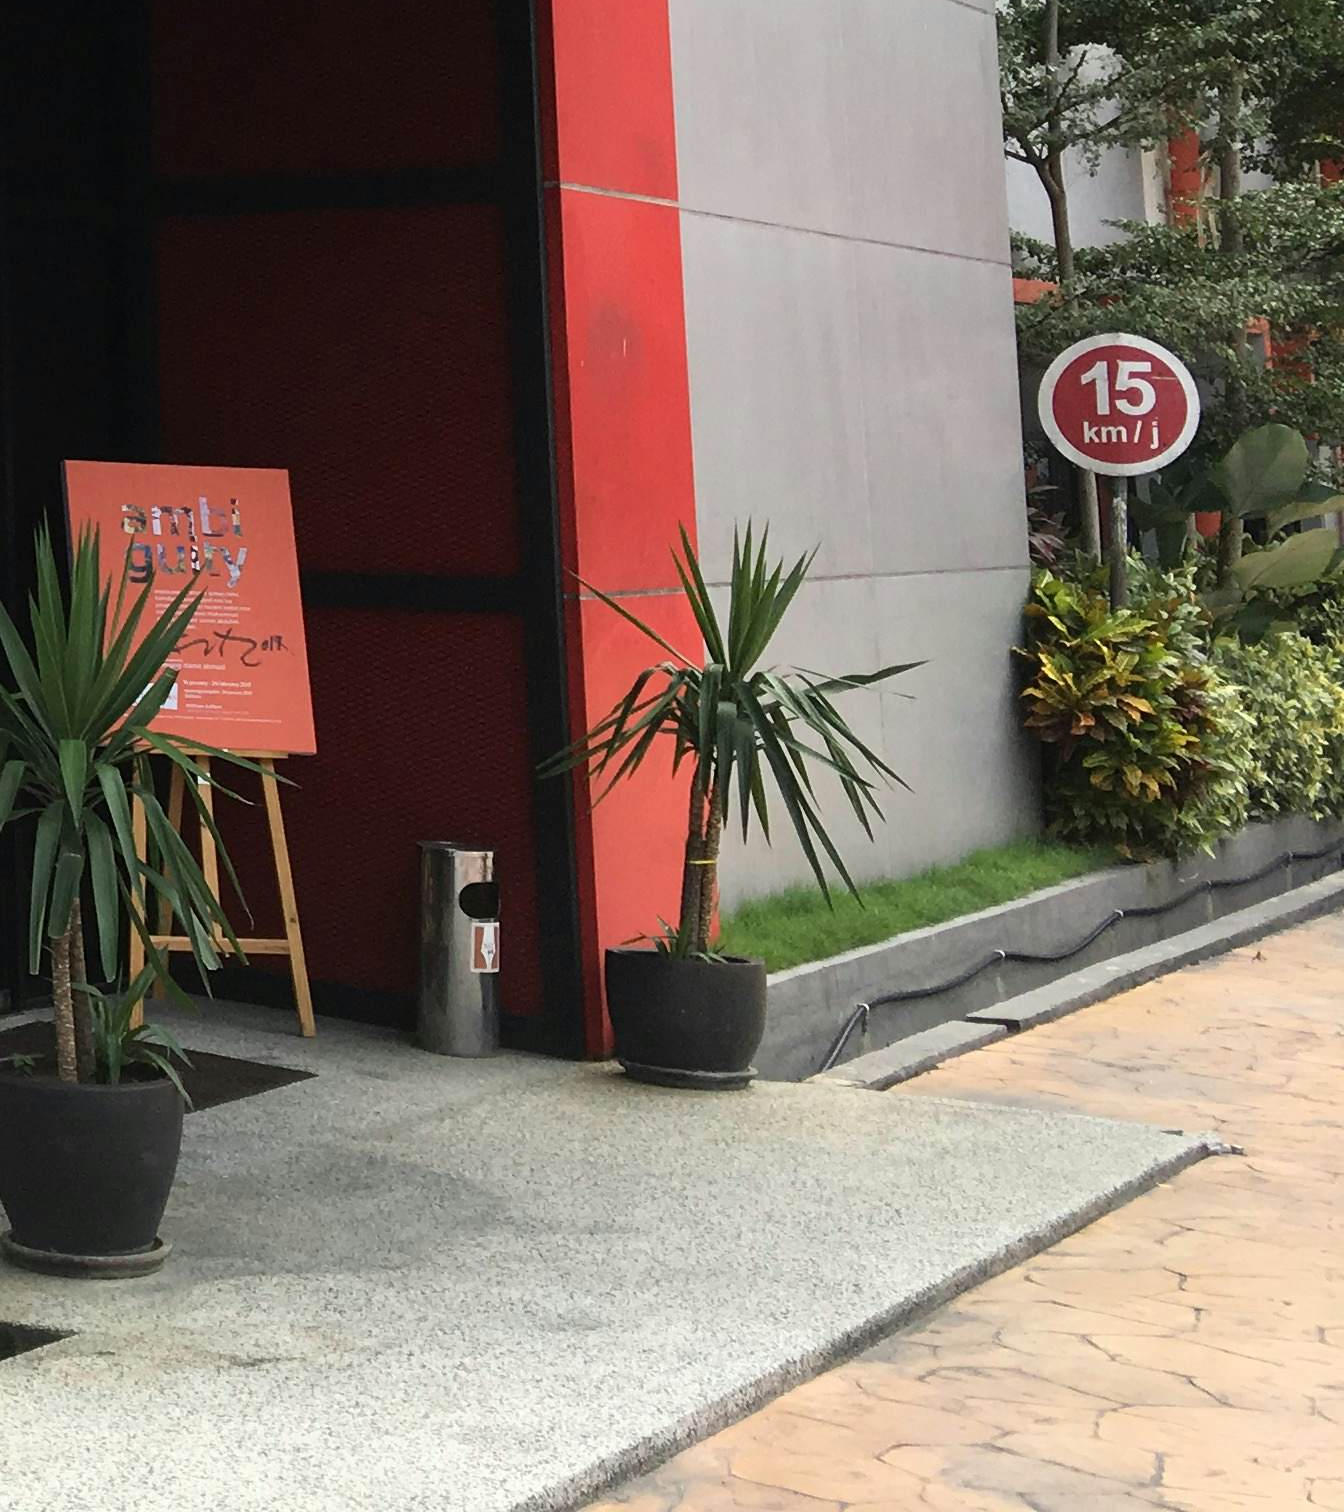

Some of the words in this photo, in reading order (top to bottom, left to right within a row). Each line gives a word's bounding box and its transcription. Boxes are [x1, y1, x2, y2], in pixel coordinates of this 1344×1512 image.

[1080, 360, 1156, 416] 15
[121, 496, 243, 538] ambi
[124, 537, 248, 589] guity
